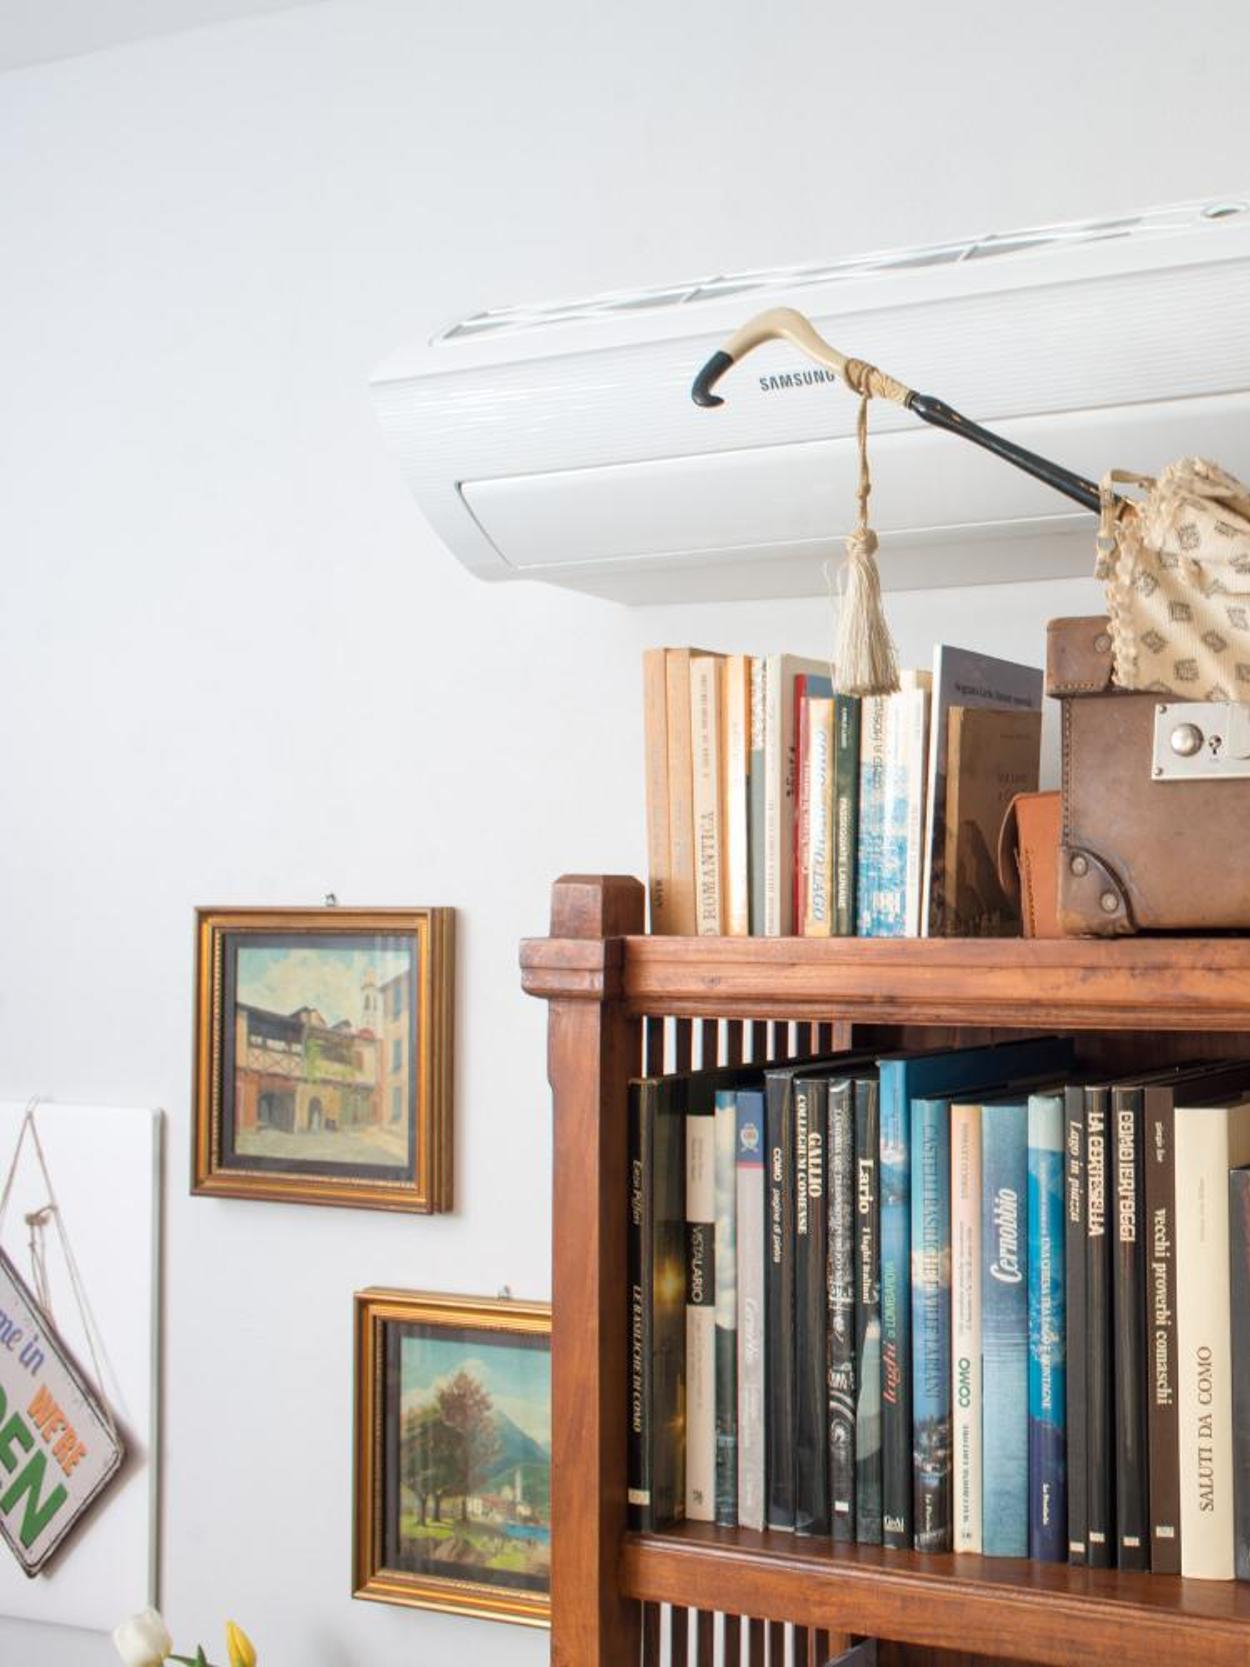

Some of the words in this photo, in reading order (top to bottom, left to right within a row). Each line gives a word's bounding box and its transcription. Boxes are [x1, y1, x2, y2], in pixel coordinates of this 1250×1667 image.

[797, 1094, 808, 1169] COLLEGIUM
[1069, 1120, 1083, 1156] Lago
[1088, 1112, 1104, 1132] LA
[1119, 1110, 1135, 1161] COMO
[772, 1147, 783, 1181] COMO
[807, 1131, 822, 1198] GALLIO
[858, 1157, 874, 1214] Lario
[1071, 1159, 1083, 1174] in
[797, 1172, 808, 1233] COMENSE
[1069, 1177, 1083, 1223] piazza
[989, 1188, 1022, 1284] Cernobbio
[1154, 1208, 1171, 1258] vecchi
[884, 1261, 897, 1328] LOMBARDIA
[1152, 1262, 1172, 1325] proverbi
[20, 1333, 45, 1376] in
[632, 1303, 642, 1374] BASILICHE
[882, 1341, 902, 1404] laghi
[958, 1358, 971, 1409] COMO
[1154, 1330, 1173, 1405] comaschi
[1196, 1345, 1213, 1406] COMO
[632, 1390, 642, 1433] COMO
[1198, 1413, 1213, 1439] DA
[1198, 1446, 1214, 1512] SALUTI
